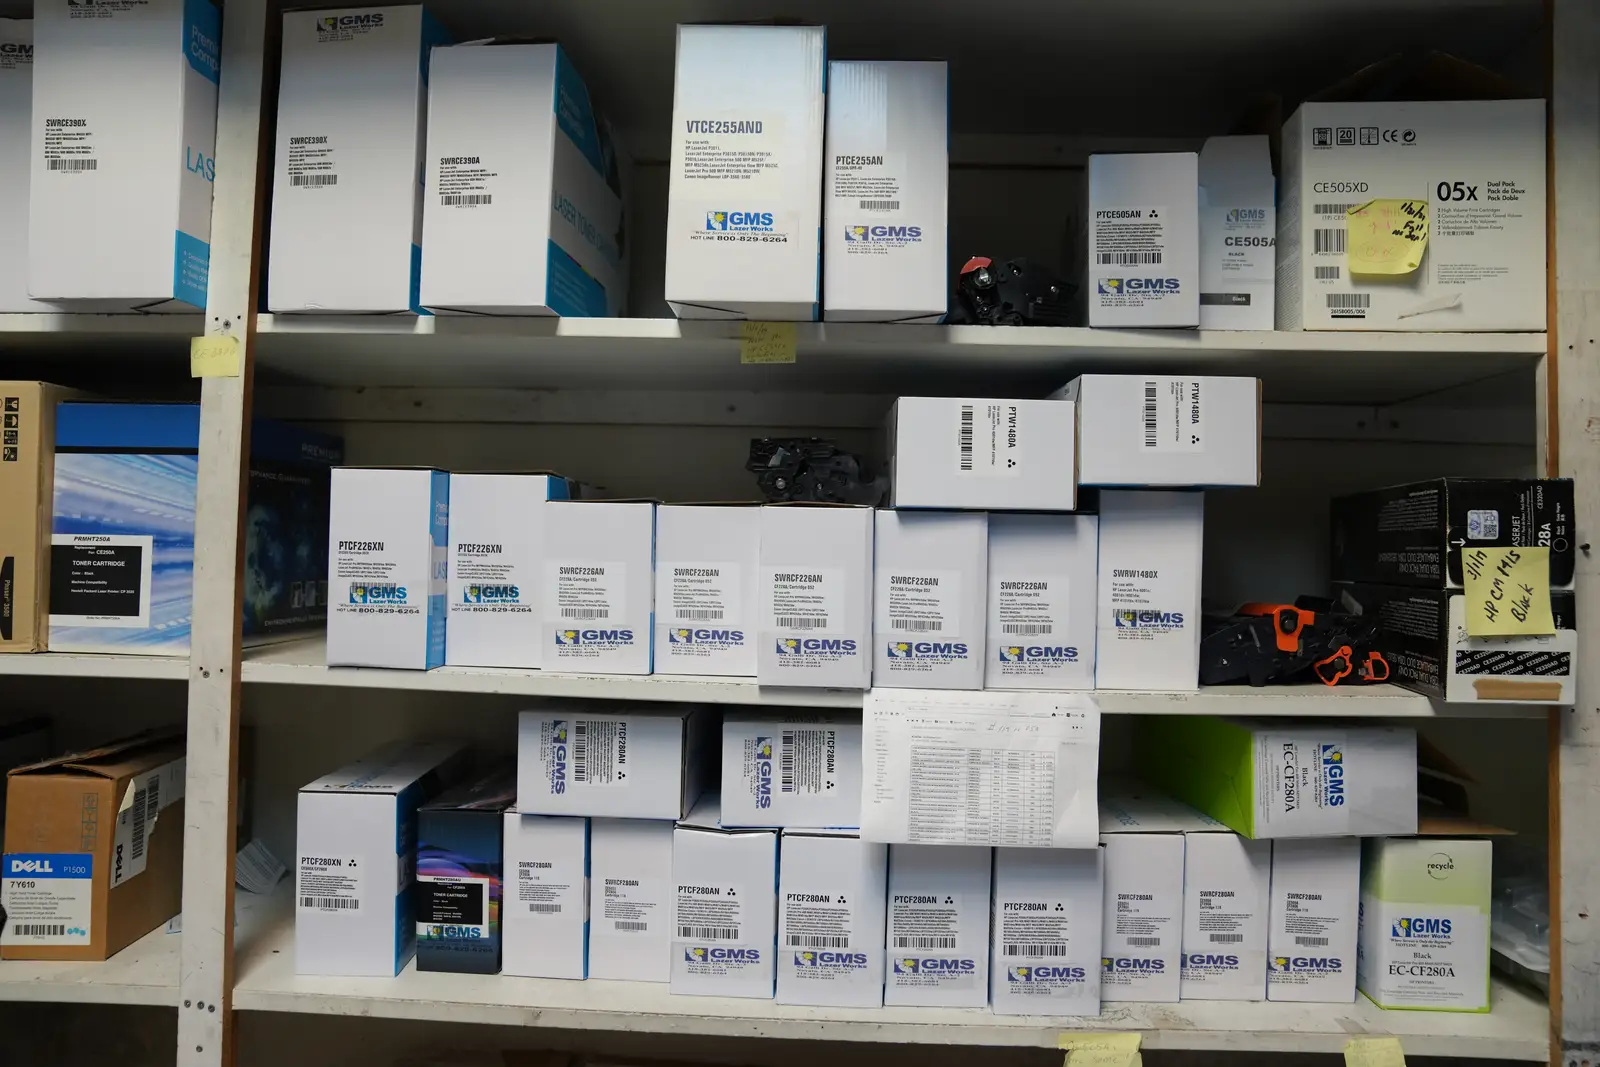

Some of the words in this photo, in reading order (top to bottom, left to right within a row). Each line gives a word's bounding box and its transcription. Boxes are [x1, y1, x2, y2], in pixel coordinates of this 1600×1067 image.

[340, 13, 384, 25] GMS
[45, 118, 87, 128] SWRCE390X
[686, 120, 763, 134] VTCE255AND
[290, 136, 328, 145] SWRCE390X
[440, 156, 480, 165] SWRCE390A
[836, 156, 883, 165] PTCE255AN
[1313, 182, 1369, 193] CE505XD
[729, 212, 774, 226] GMS
[1096, 210, 1141, 219] PTCE505AN
[1240, 209, 1265, 219] GMS
[870, 226, 922, 237] GMS
[1125, 278, 1180, 289] GMS
[1191, 382, 1200, 425] PTW1480A
[1008, 406, 1017, 448] PTW1480A
[1511, 515, 1521, 547] ASERJET
[1538, 522, 1552, 547] 28A
[338, 541, 384, 551] PTCF226XN
[458, 543, 502, 553] PTCF226XN
[559, 566, 605, 575] SWRCF226AN
[674, 568, 720, 577] SWRCF226AN
[1113, 569, 1158, 578] SWRW1480X
[774, 573, 823, 583] SWRCF226AN
[891, 576, 939, 586] SWRCF226AN
[1000, 581, 1048, 590] SWRCF226AN
[368, 586, 408, 599] GMS
[481, 586, 520, 598] GMS
[1510, 583, 1534, 622] Black
[1484, 600, 1499, 622] HP
[1139, 612, 1184, 623] GMS
[581, 630, 634, 641] GMS
[694, 629, 744, 641] GMS
[803, 639, 857, 650] GMS
[914, 643, 968, 654] GMS
[1025, 646, 1078, 657] GMS
[1483, 653, 1506, 666] CE320AD
[1492, 659, 1515, 671] CE320AD
[1526, 654, 1549, 667] CE320AD
[1535, 660, 1558, 672] CE320AD
[618, 722, 627, 764] PTCF280AN
[827, 731, 835, 773] PTCF280AN
[555, 745, 567, 794] GMS
[1283, 742, 1296, 813] EC-CF280A
[760, 761, 772, 809] GMS
[1328, 764, 1344, 807] GMS
[11, 860, 53, 873] DELL
[115, 843, 123, 883] DELL
[301, 856, 342, 866] PTCF280XN
[1427, 862, 1454, 870] recycle
[678, 886, 720, 895] PTCF280AN
[787, 893, 830, 903] PTCF280AN
[894, 896, 937, 904] PTCF280AN
[1287, 892, 1323, 901] SWRCF280AN
[1004, 902, 1047, 911] PTCF280AN
[1412, 918, 1452, 934] GMS
[444, 926, 481, 938] GMS
[710, 948, 760, 959] GMS
[818, 952, 867, 964] GMS
[921, 959, 975, 969] GMS
[1115, 958, 1165, 969] GMS
[1189, 954, 1239, 965] GMS
[1292, 957, 1342, 968] GMS
[1034, 967, 1086, 978] GMS
[1388, 965, 1456, 977] EC-CF280A
